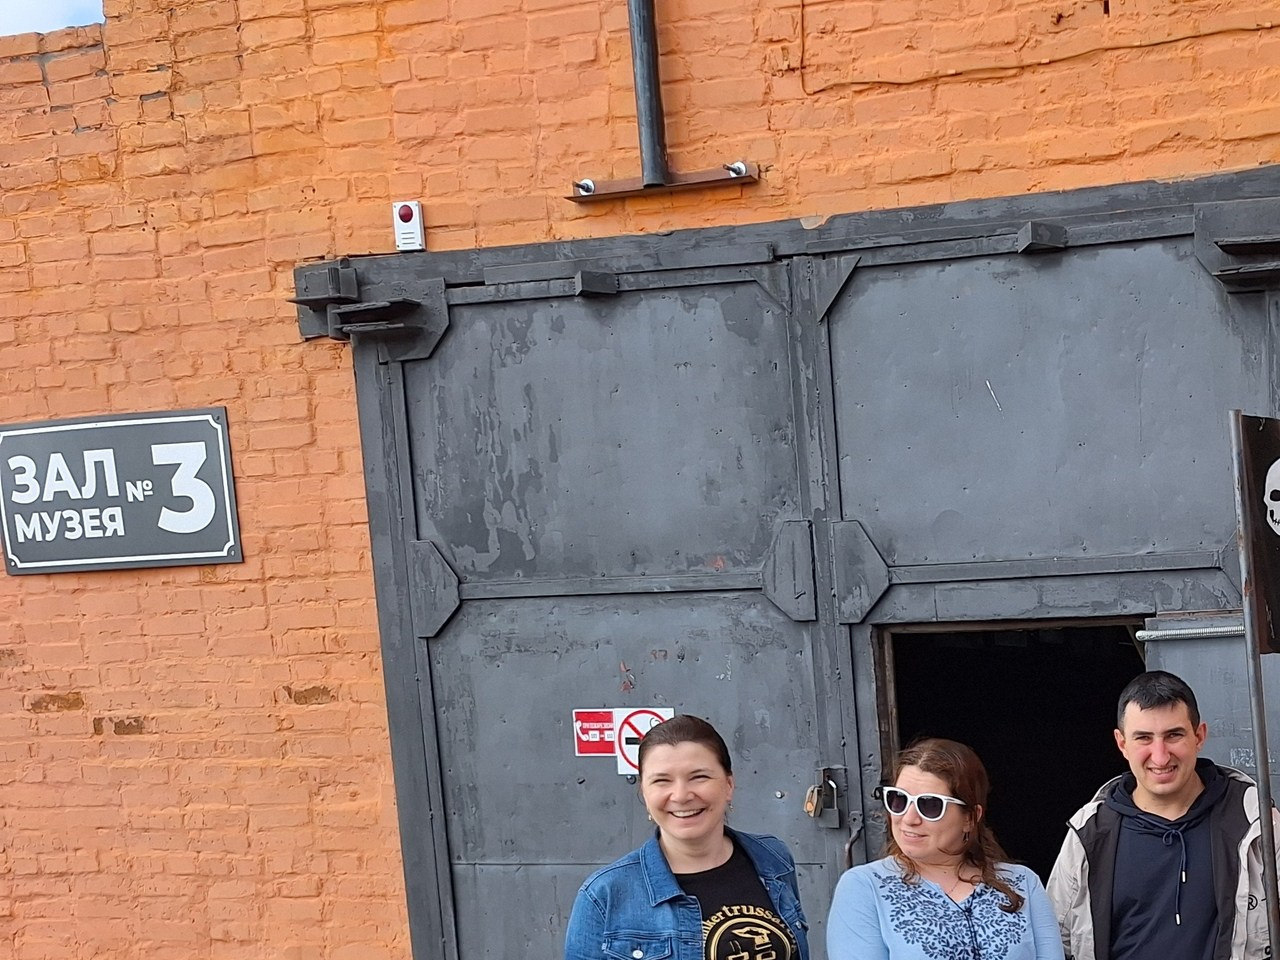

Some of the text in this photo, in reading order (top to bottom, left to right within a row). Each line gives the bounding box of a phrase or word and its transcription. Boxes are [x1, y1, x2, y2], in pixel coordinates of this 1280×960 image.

[7, 441, 216, 534] ЗАЛ № 3
[14, 506, 125, 543] МУЗЕЯ
